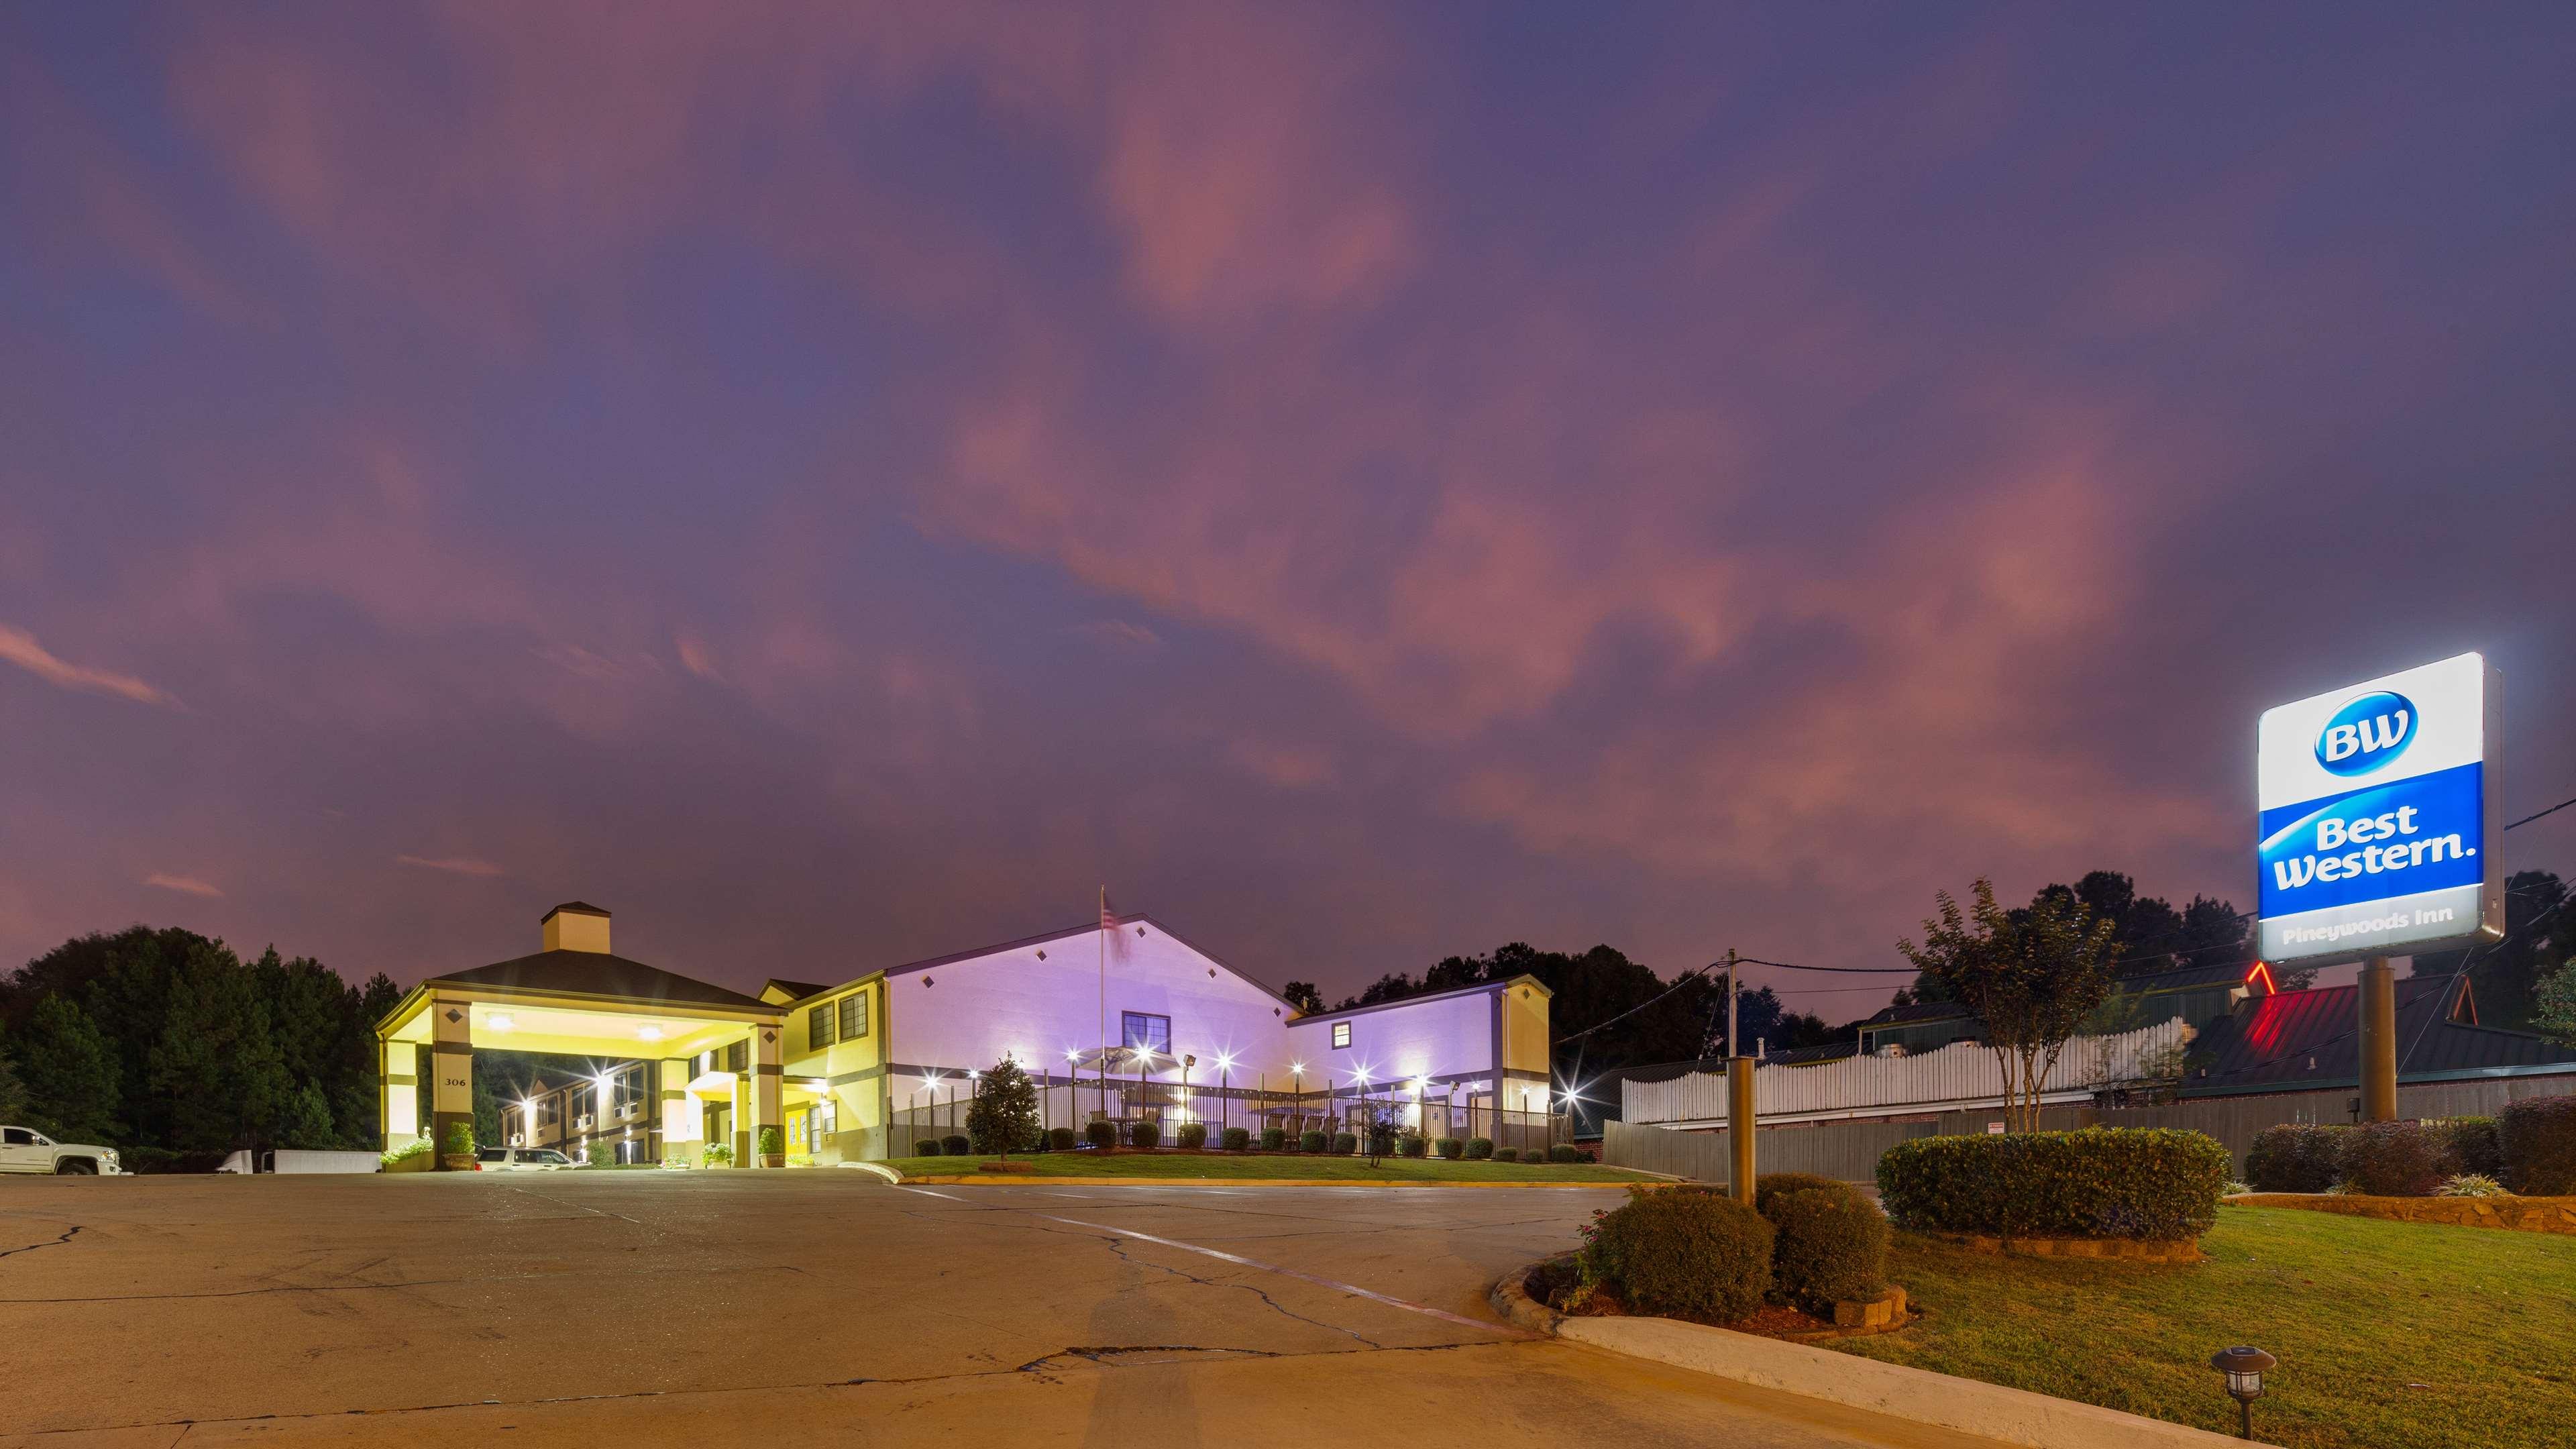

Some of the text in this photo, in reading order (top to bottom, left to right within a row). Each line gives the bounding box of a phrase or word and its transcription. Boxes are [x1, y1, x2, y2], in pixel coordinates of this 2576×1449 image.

[2326, 709, 2409, 762] BW
[2317, 806, 2419, 851] Best
[2283, 908, 2453, 945] Pineywoods Inn
[445, 1078, 466, 1087] 306
